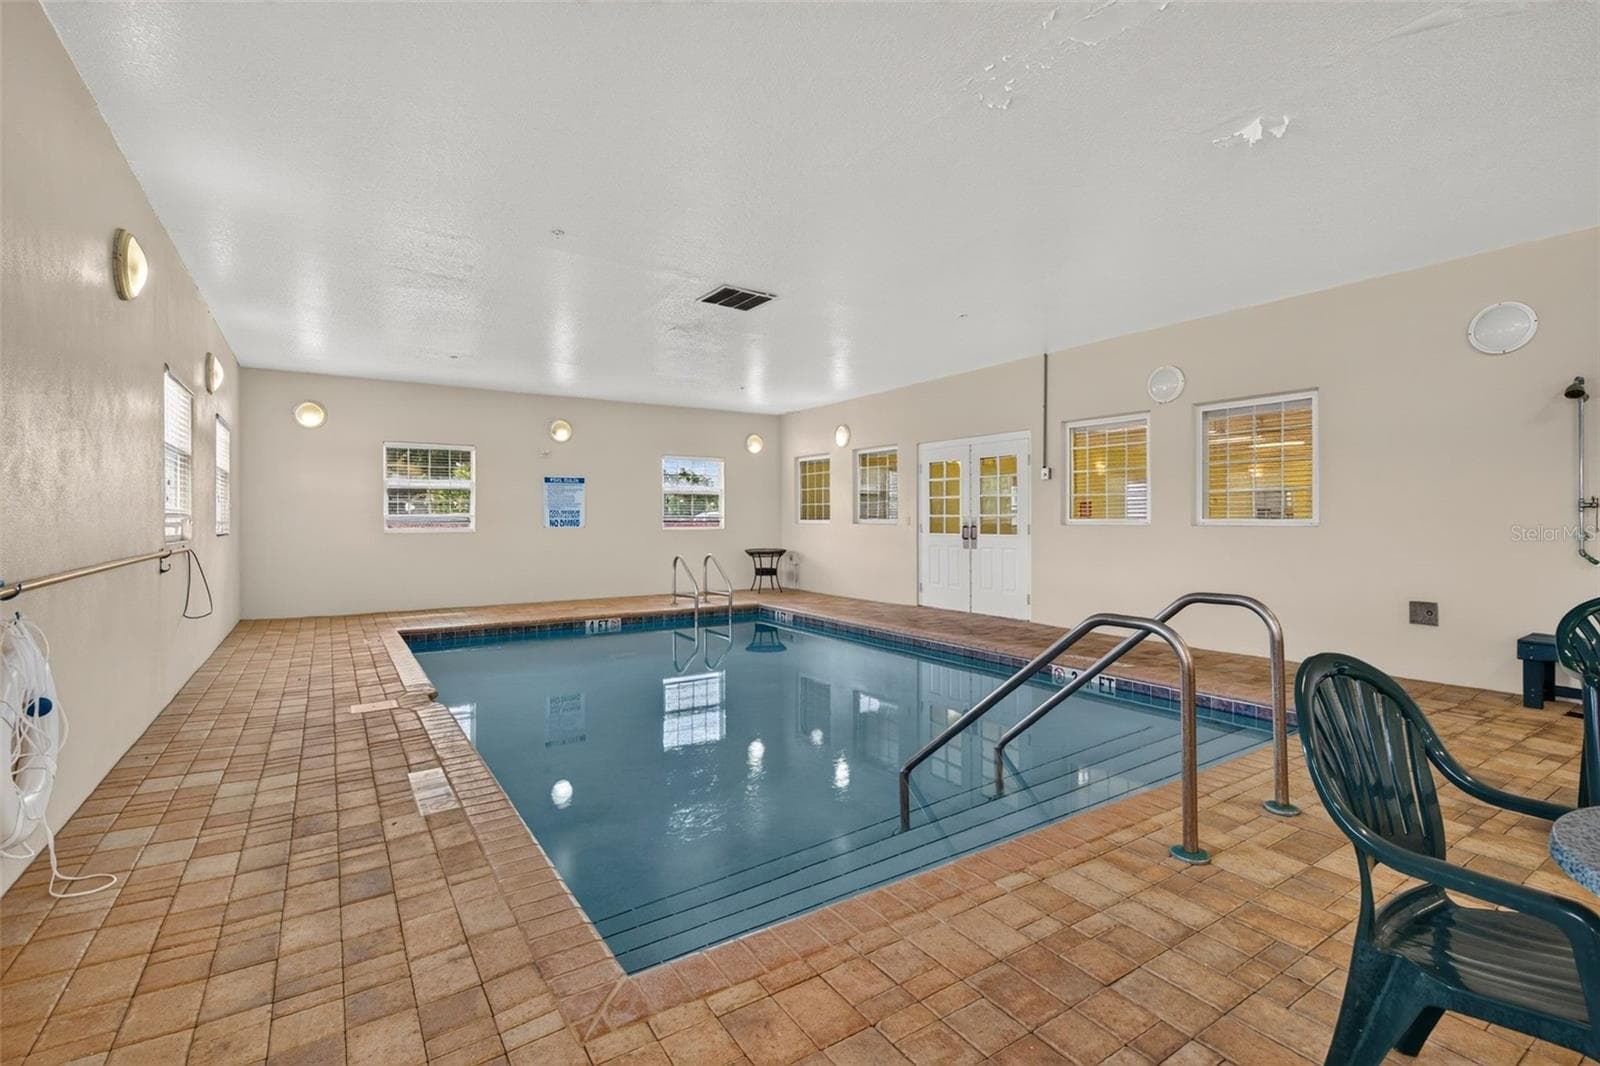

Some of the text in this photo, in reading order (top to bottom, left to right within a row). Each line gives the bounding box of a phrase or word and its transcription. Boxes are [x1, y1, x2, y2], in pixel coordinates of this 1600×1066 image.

[549, 519, 580, 527] NO DIVING
[598, 619, 609, 630] FT
[1099, 675, 1115, 692] FT
